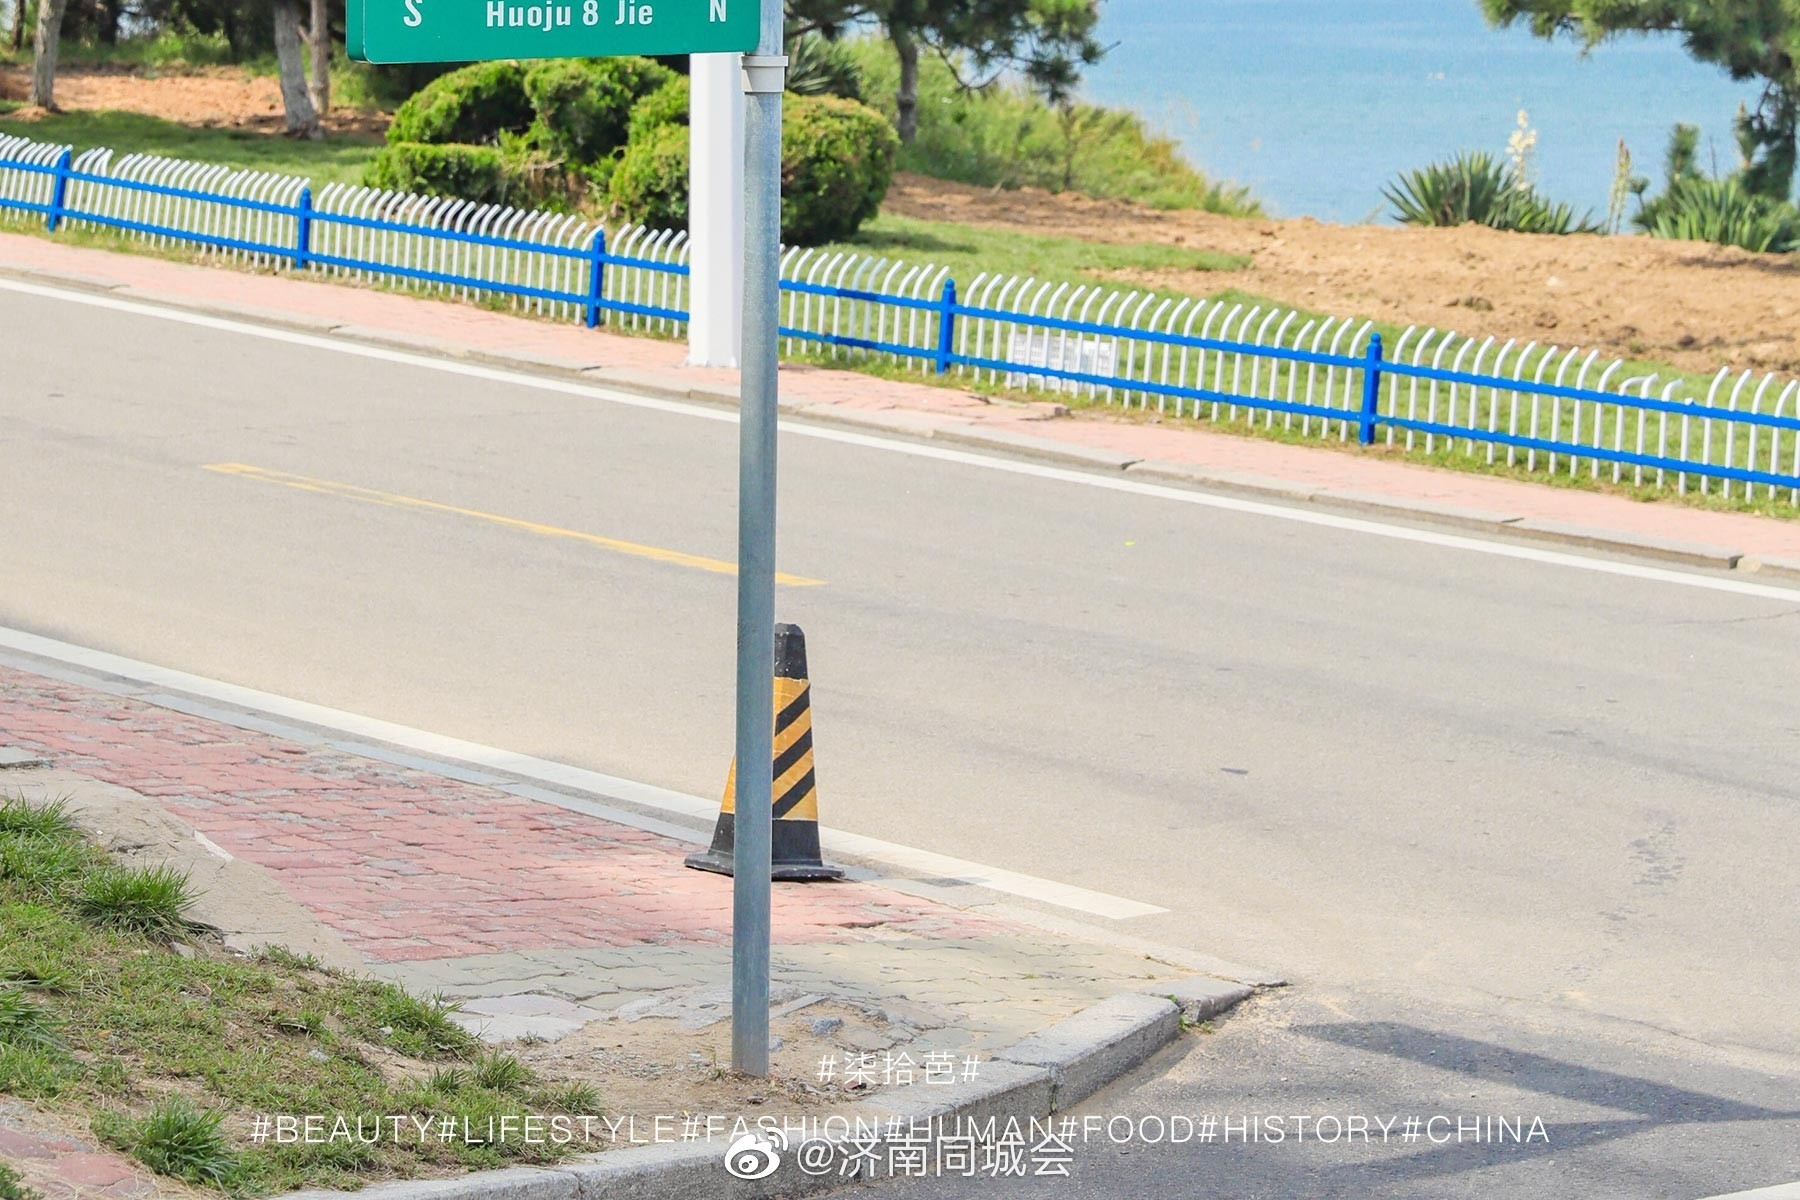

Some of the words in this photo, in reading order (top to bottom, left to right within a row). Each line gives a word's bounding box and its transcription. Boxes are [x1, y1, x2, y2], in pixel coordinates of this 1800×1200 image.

[487, 0, 571, 32] Huoju
[582, 0, 599, 26] 8
[615, 0, 653, 25] Jie
